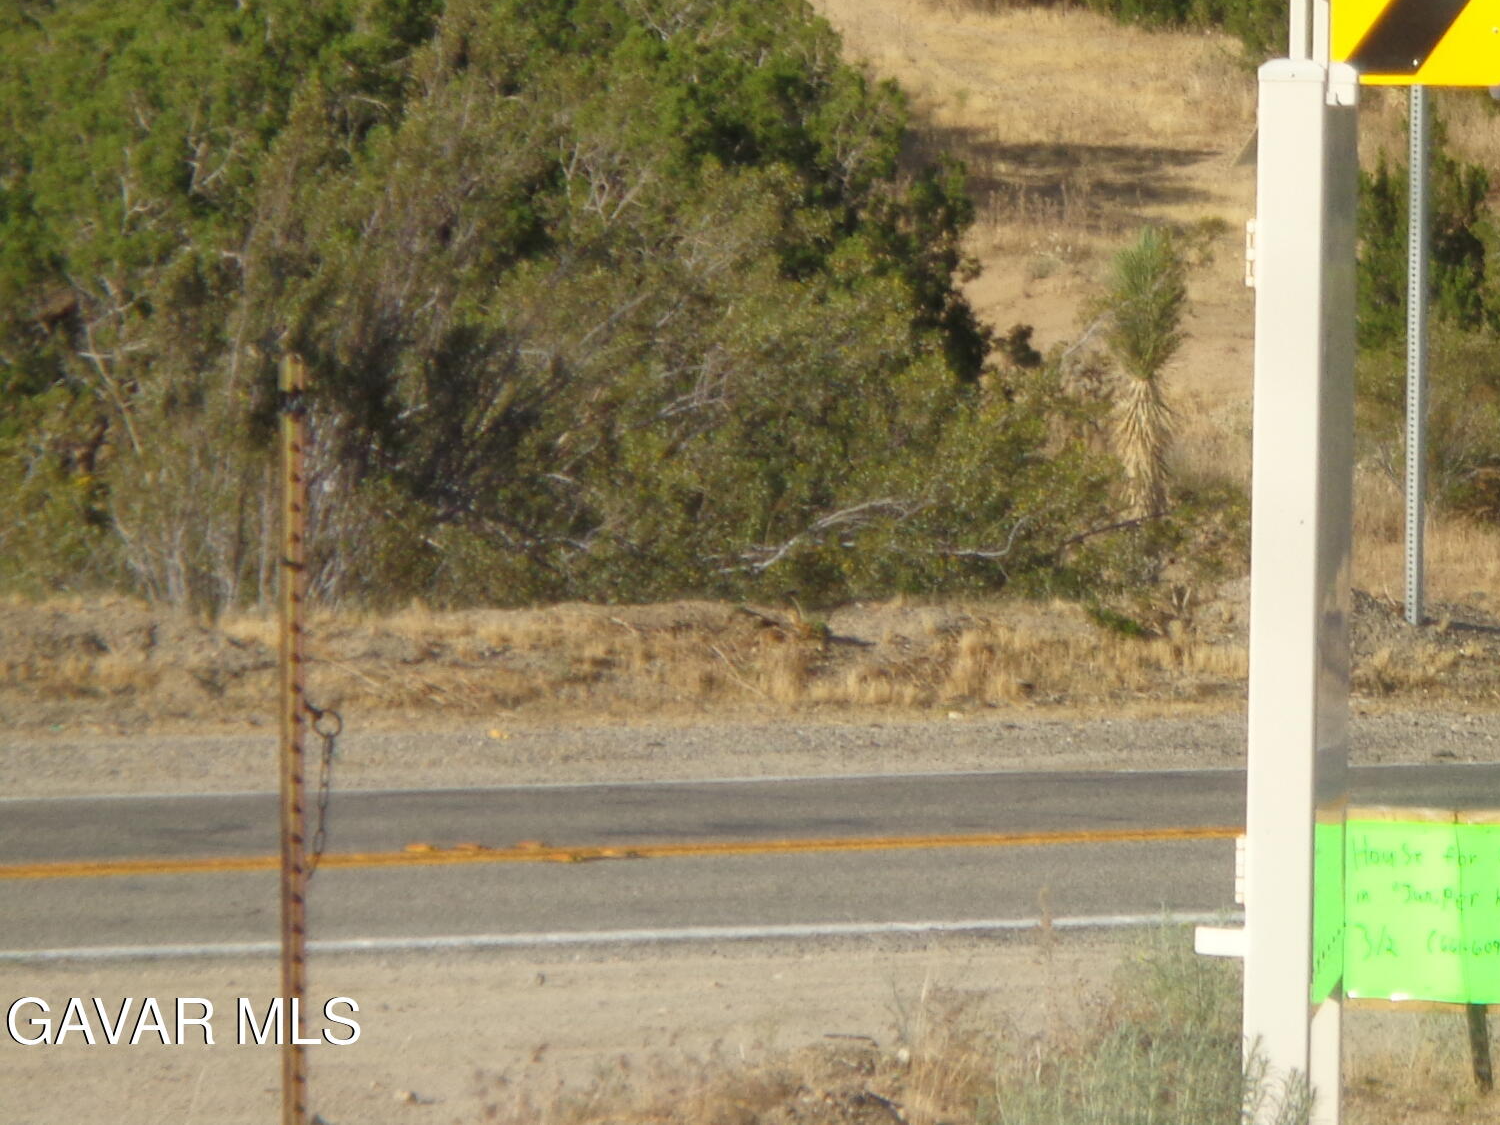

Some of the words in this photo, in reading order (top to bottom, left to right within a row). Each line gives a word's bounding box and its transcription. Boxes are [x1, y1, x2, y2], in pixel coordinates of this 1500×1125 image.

[1352, 834, 1424, 870] House
[1442, 844, 1479, 867] for
[1355, 889, 1371, 904] in
